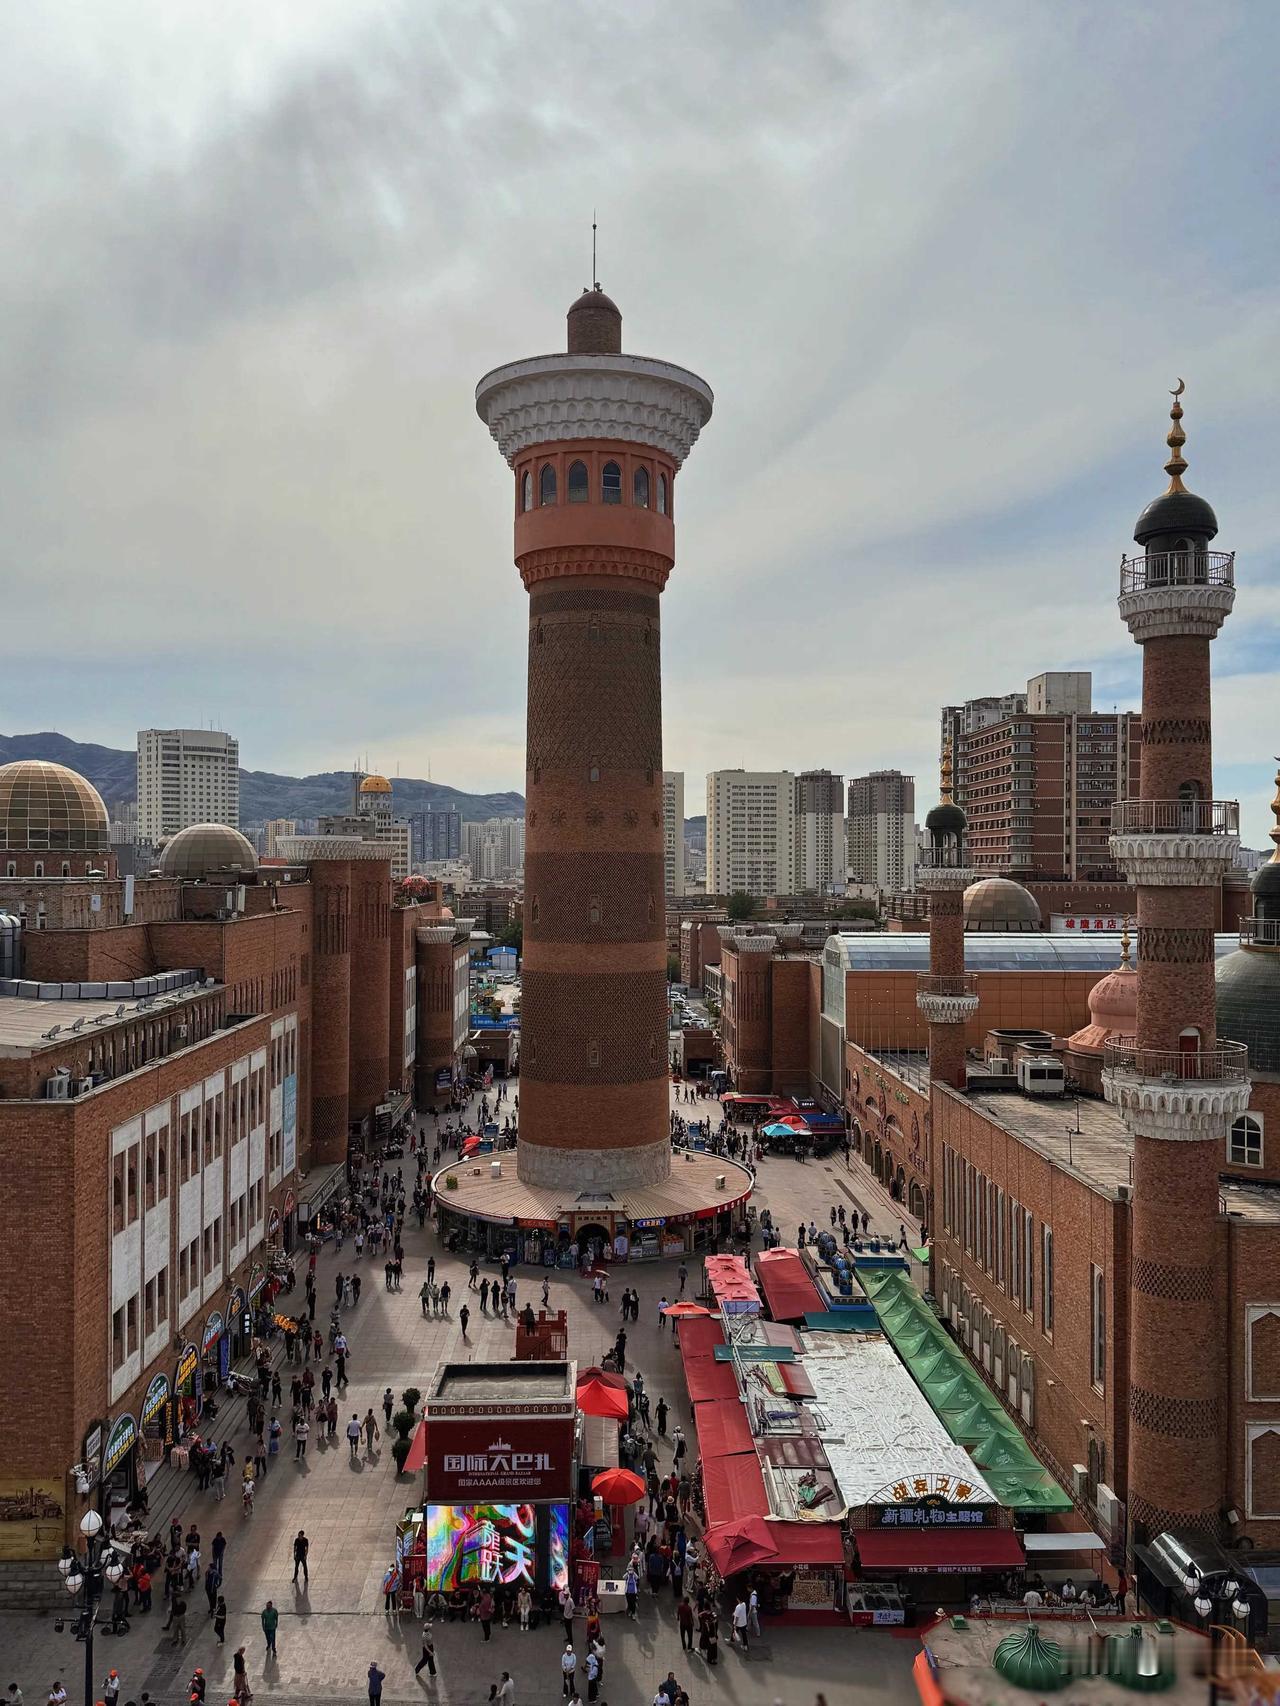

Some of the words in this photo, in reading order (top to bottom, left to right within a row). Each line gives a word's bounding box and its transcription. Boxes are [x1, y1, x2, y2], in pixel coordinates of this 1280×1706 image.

[443, 1453, 556, 1472] 国际大巴扎
[881, 1507, 984, 1525] 新疆礼物主题馆
